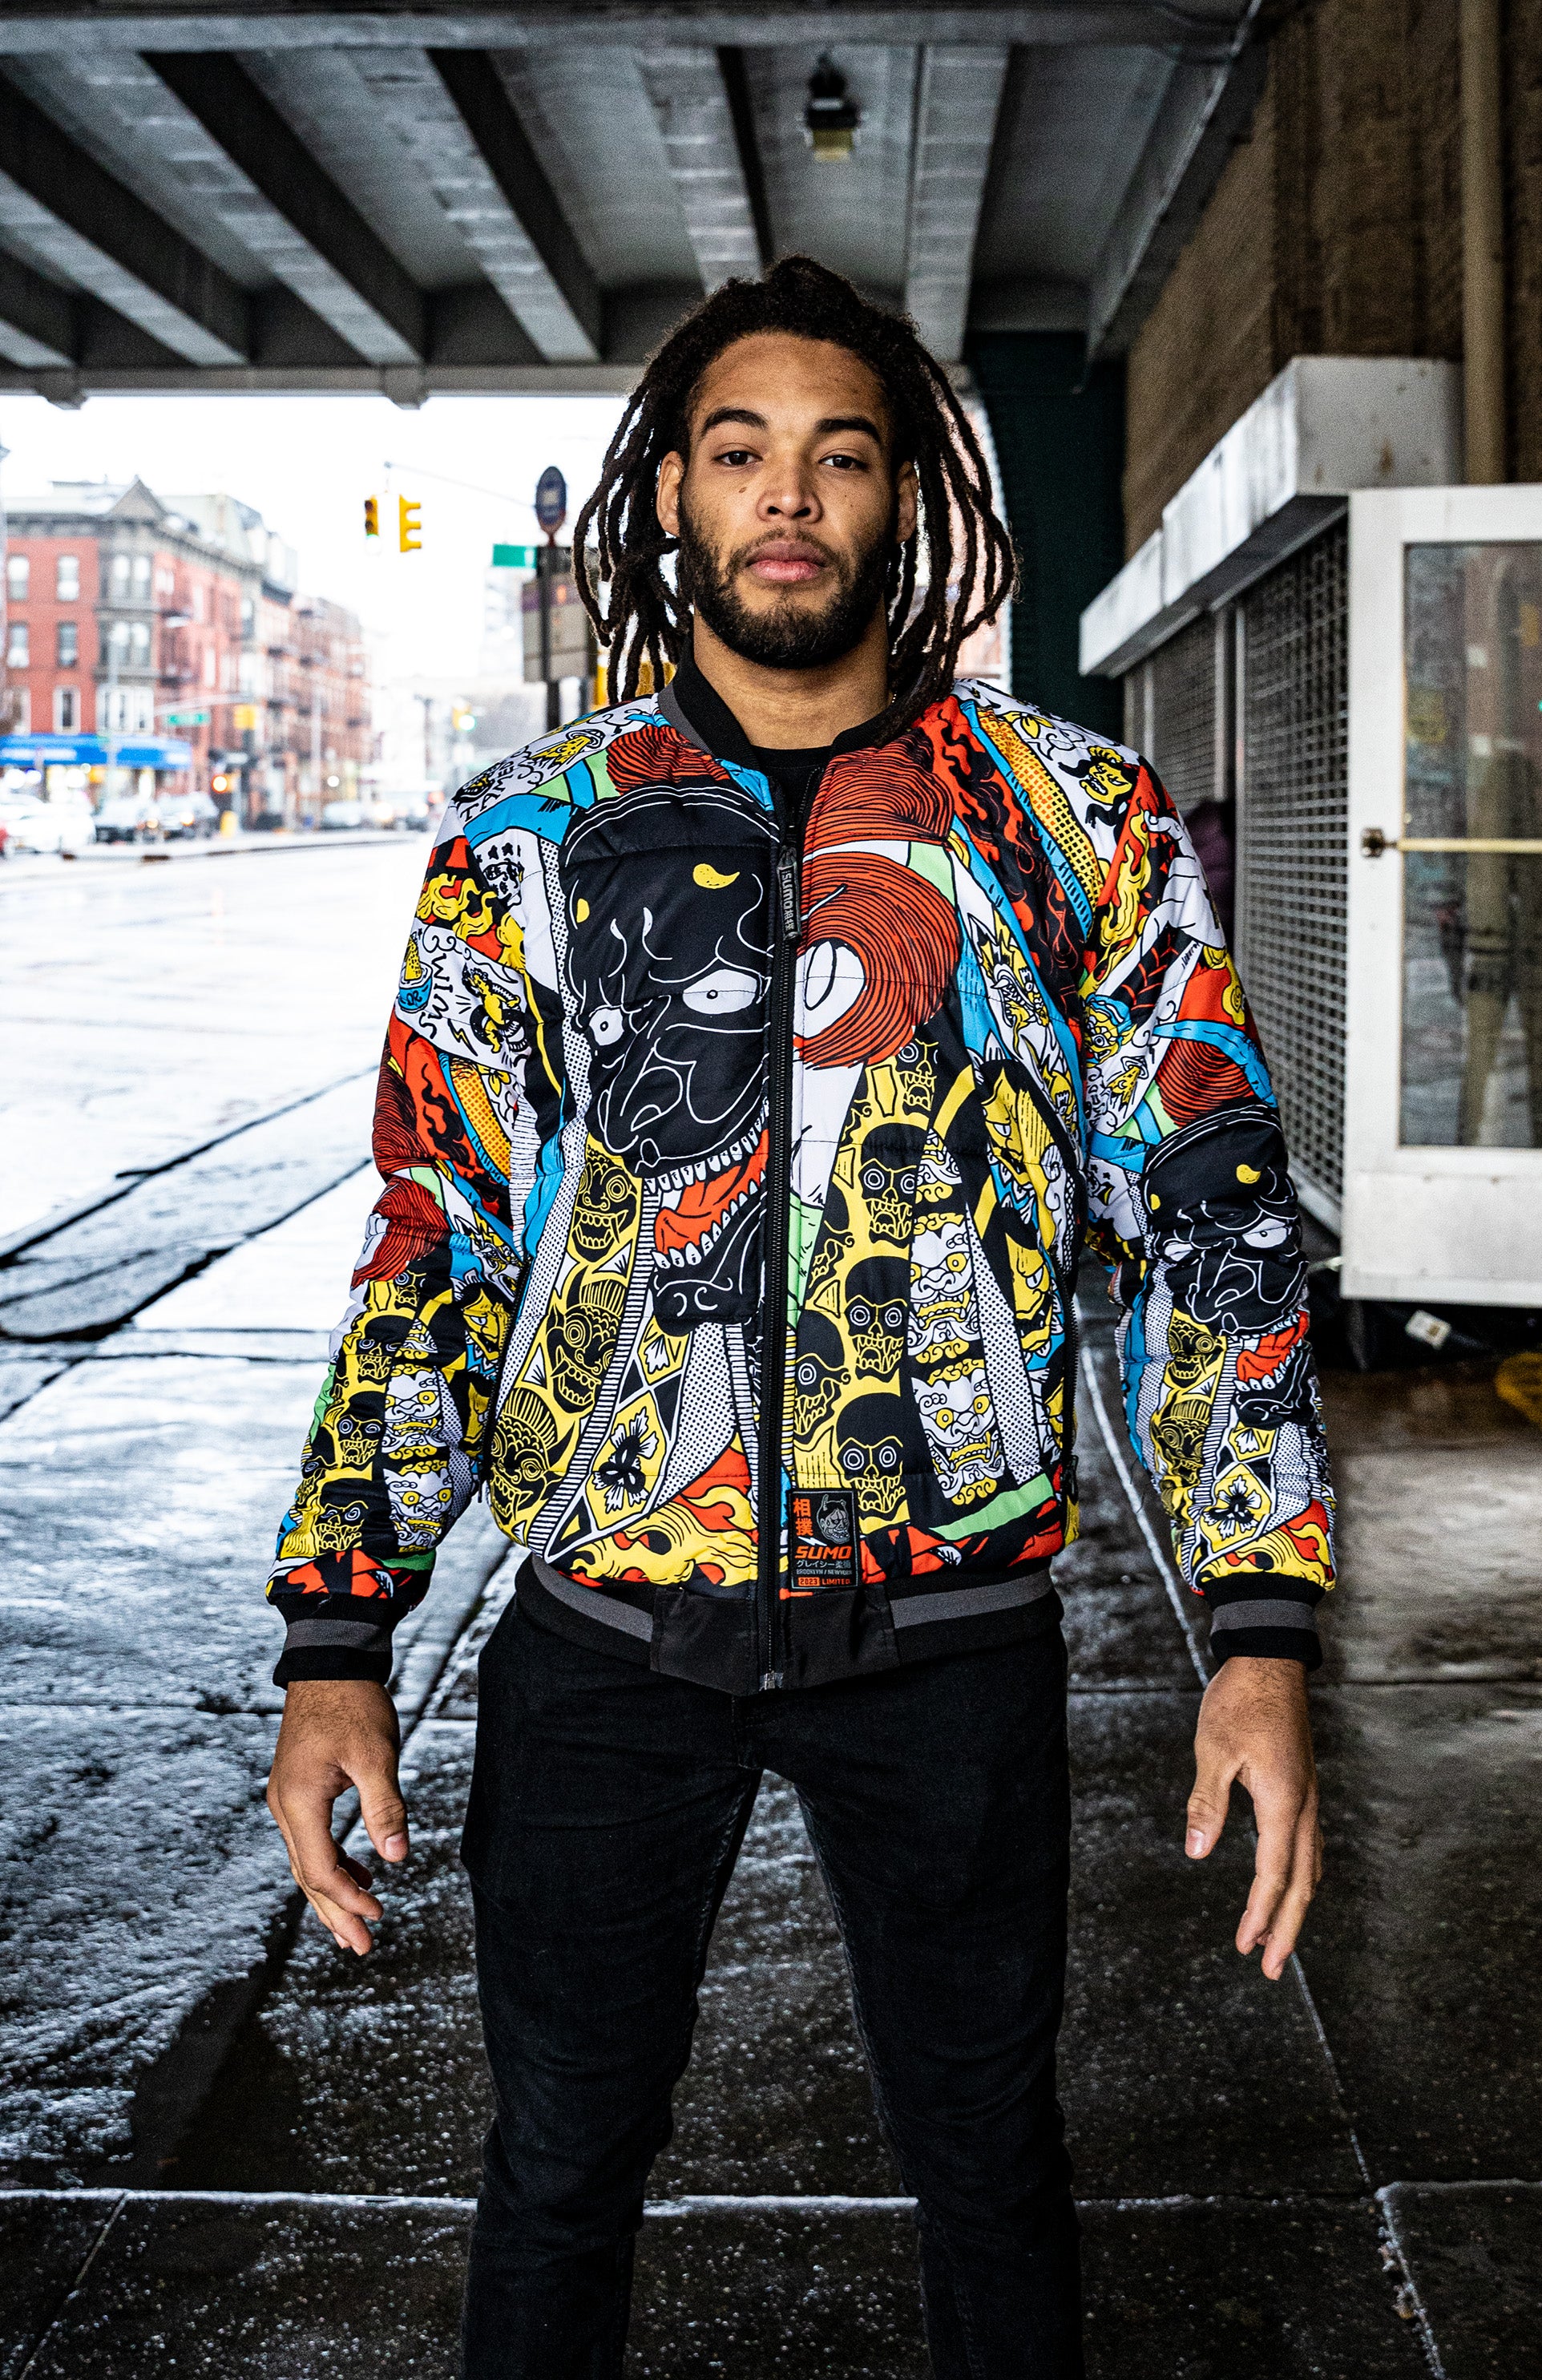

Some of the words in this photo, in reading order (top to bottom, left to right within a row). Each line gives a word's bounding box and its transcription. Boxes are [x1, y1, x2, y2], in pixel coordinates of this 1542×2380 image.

[782, 875, 793, 909] SUMO
[793, 1497, 813, 1536] 相撲
[794, 1546, 852, 1559] SUMO
